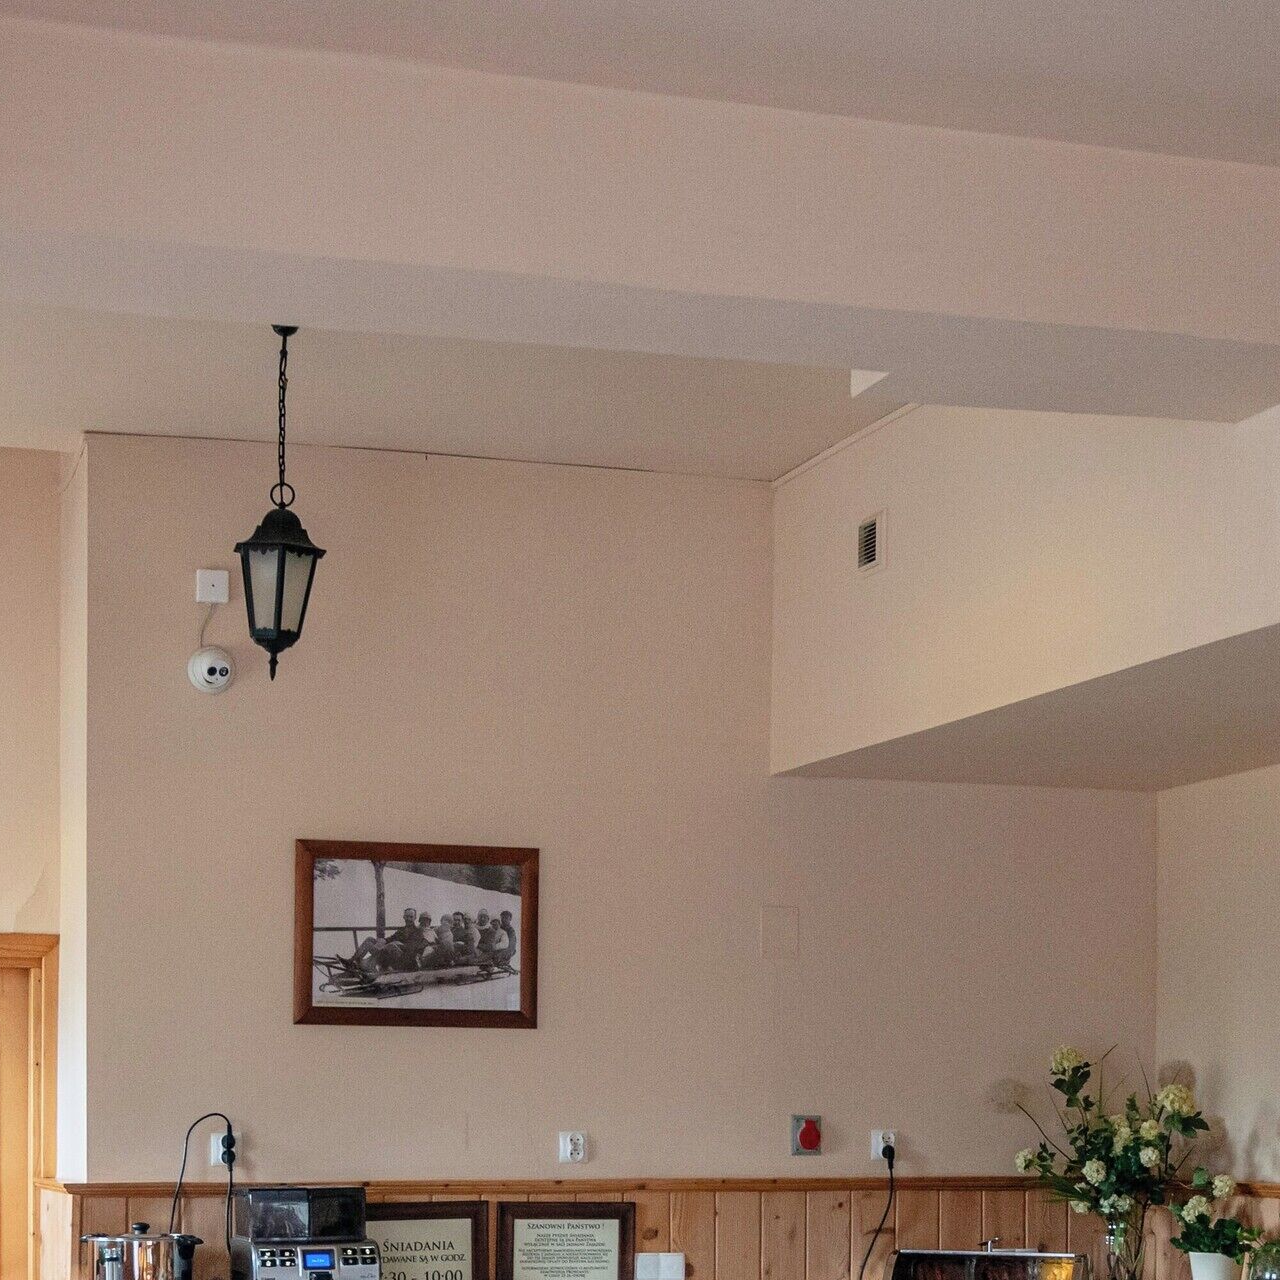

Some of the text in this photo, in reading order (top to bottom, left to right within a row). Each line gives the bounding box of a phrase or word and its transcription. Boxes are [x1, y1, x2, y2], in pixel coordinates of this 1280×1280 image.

[383, 1239, 455, 1252] ŚNIADANIA
[381, 1255, 417, 1263] DAWANE
[419, 1255, 429, 1264] SĄ
